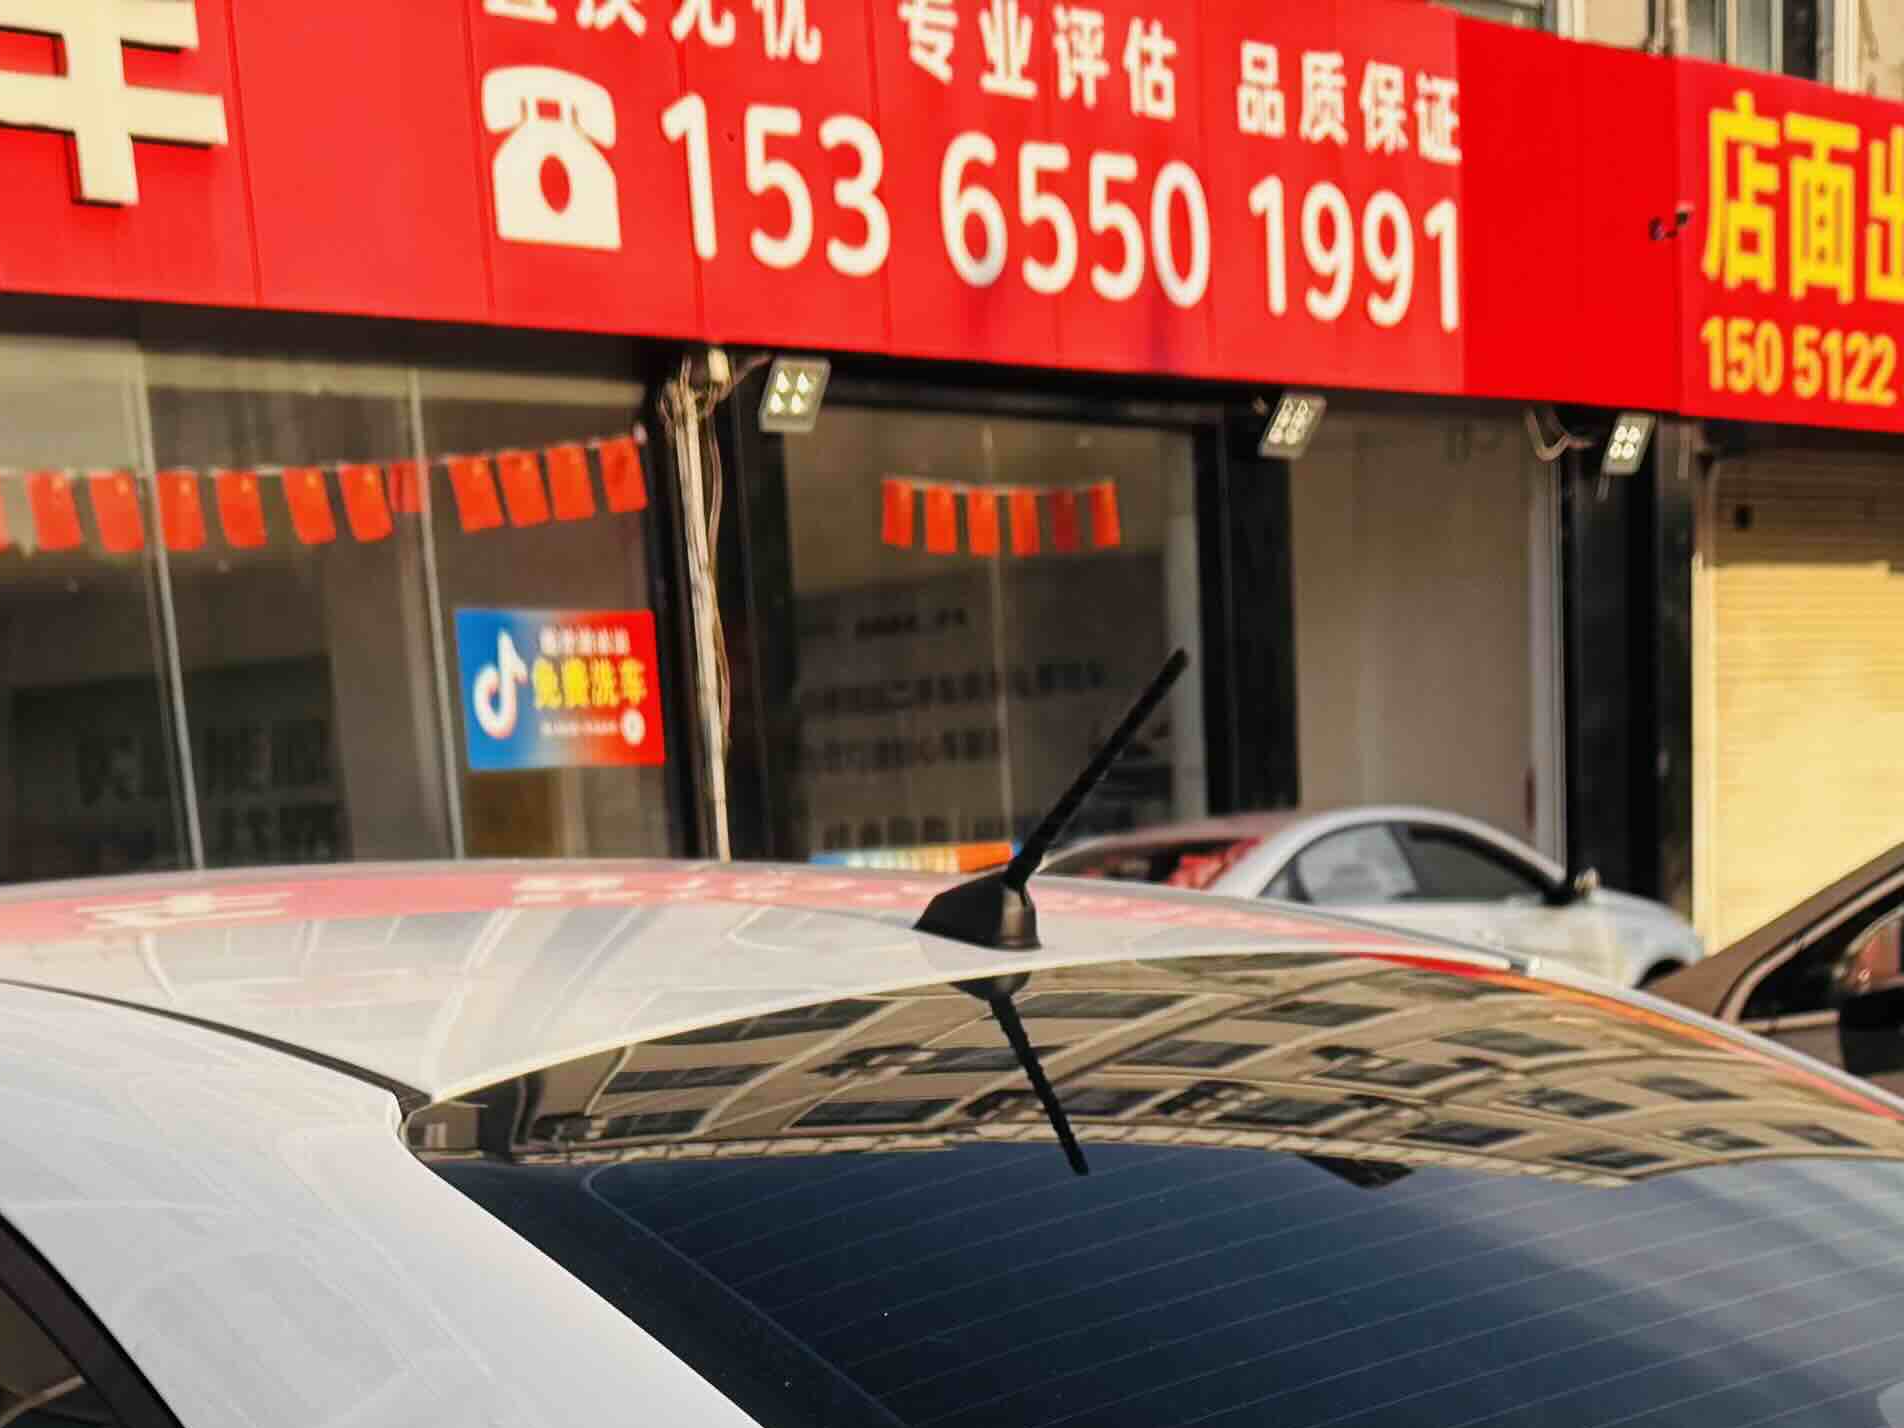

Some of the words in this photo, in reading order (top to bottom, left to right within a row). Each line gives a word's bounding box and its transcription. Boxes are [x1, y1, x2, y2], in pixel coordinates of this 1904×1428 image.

[897, 0, 1178, 121] 专业评估
[1237, 39, 1463, 166] 品质保证
[661, 91, 892, 278] 153
[939, 131, 1211, 309] 6550
[1246, 175, 1461, 333] 1991
[1701, 315, 1784, 395] 150
[1792, 324, 1896, 407] 5122
